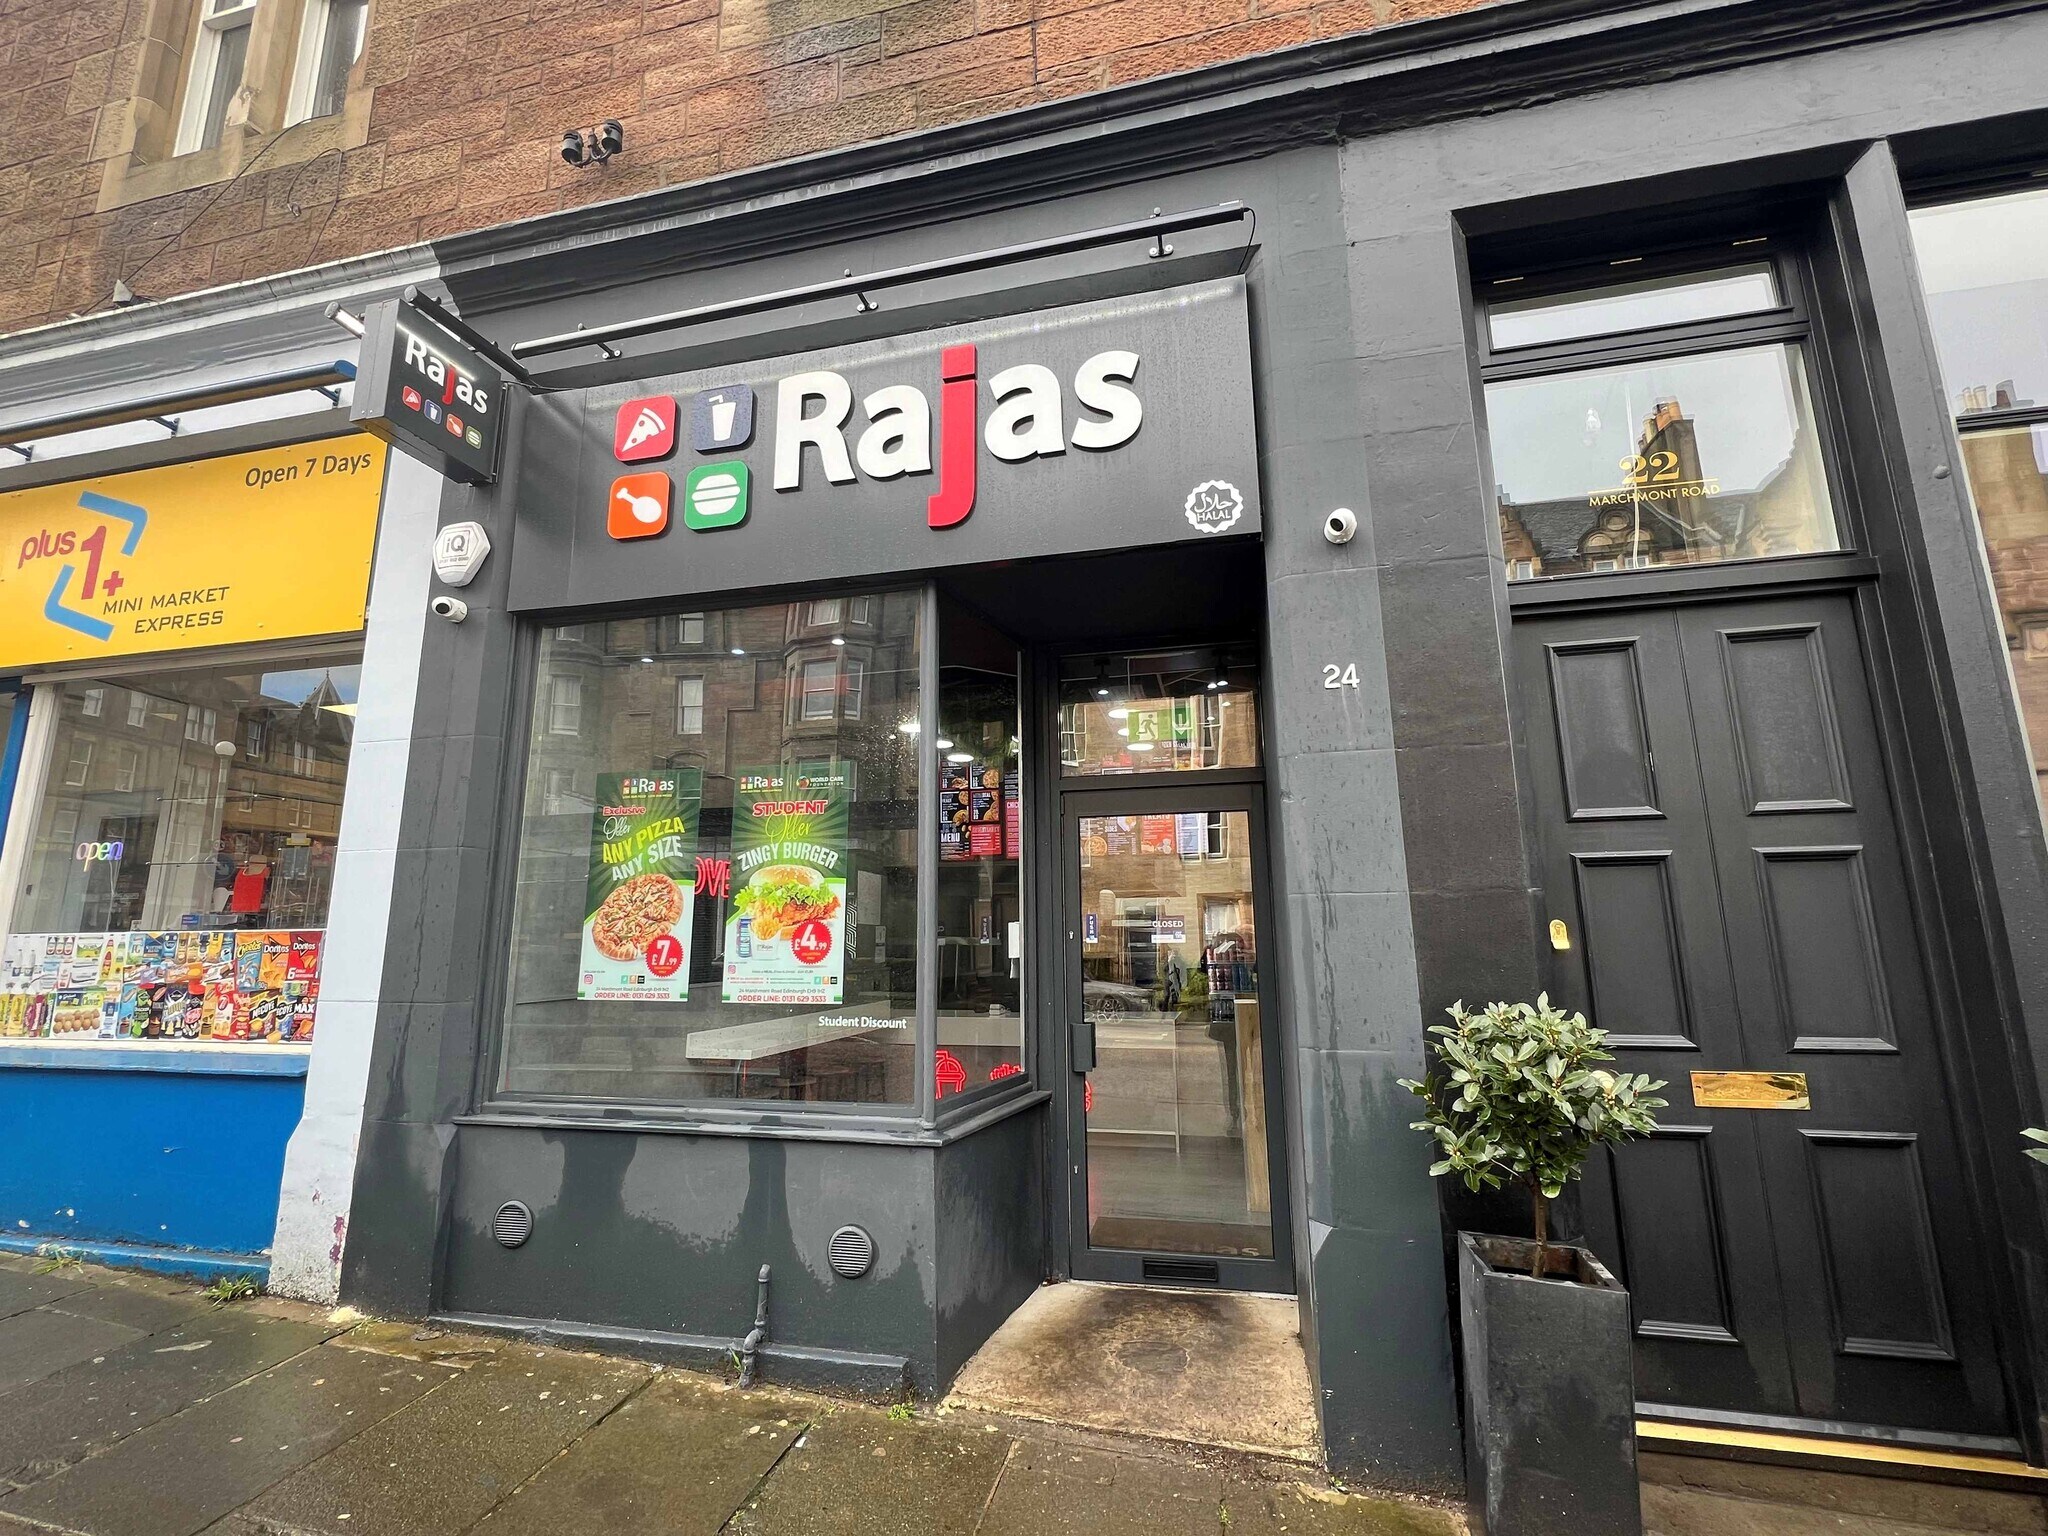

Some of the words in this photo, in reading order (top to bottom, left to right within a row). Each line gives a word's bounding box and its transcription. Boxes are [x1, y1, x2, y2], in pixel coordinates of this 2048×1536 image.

[405, 334, 488, 414] Rajas
[773, 343, 1143, 528] Rajas
[245, 465, 298, 489] Open
[305, 458, 317, 478] 7
[322, 453, 371, 475] Days
[1619, 451, 1680, 485] 22
[1589, 489, 1677, 507] MARCHMONT
[1682, 485, 1721, 497] ROAD
[1197, 509, 1231, 522] HALAL
[18, 529, 76, 569] plus
[103, 597, 143, 615] MINI
[151, 587, 230, 608] MARKET
[134, 611, 224, 634] EXPRESS
[1322, 663, 1361, 690] 24
[639, 778, 674, 793] Rajas
[754, 776, 784, 790] Rajas
[603, 806, 646, 816] Exclusive
[753, 800, 829, 816] STUDENT
[603, 817, 633, 840] Offer
[765, 810, 812, 845] Offer
[941, 833, 960, 842] MENU
[603, 838, 633, 864] ANY
[636, 817, 685, 849] PIZZA
[75, 841, 124, 872] open
[612, 853, 643, 881] ANY
[647, 835, 683, 863] SIZE
[737, 843, 779, 872] ZINGY
[783, 842, 839, 870] BURGER
[1152, 920, 1184, 928] CLOSED
[263, 945, 290, 953] Doritos
[293, 942, 316, 950] Doritos
[794, 924, 827, 950] £4.99
[652, 939, 678, 966] £7.99
[294, 1004, 314, 1013] MAX
[819, 1016, 859, 1027] Student
[861, 1017, 907, 1029] Discount
